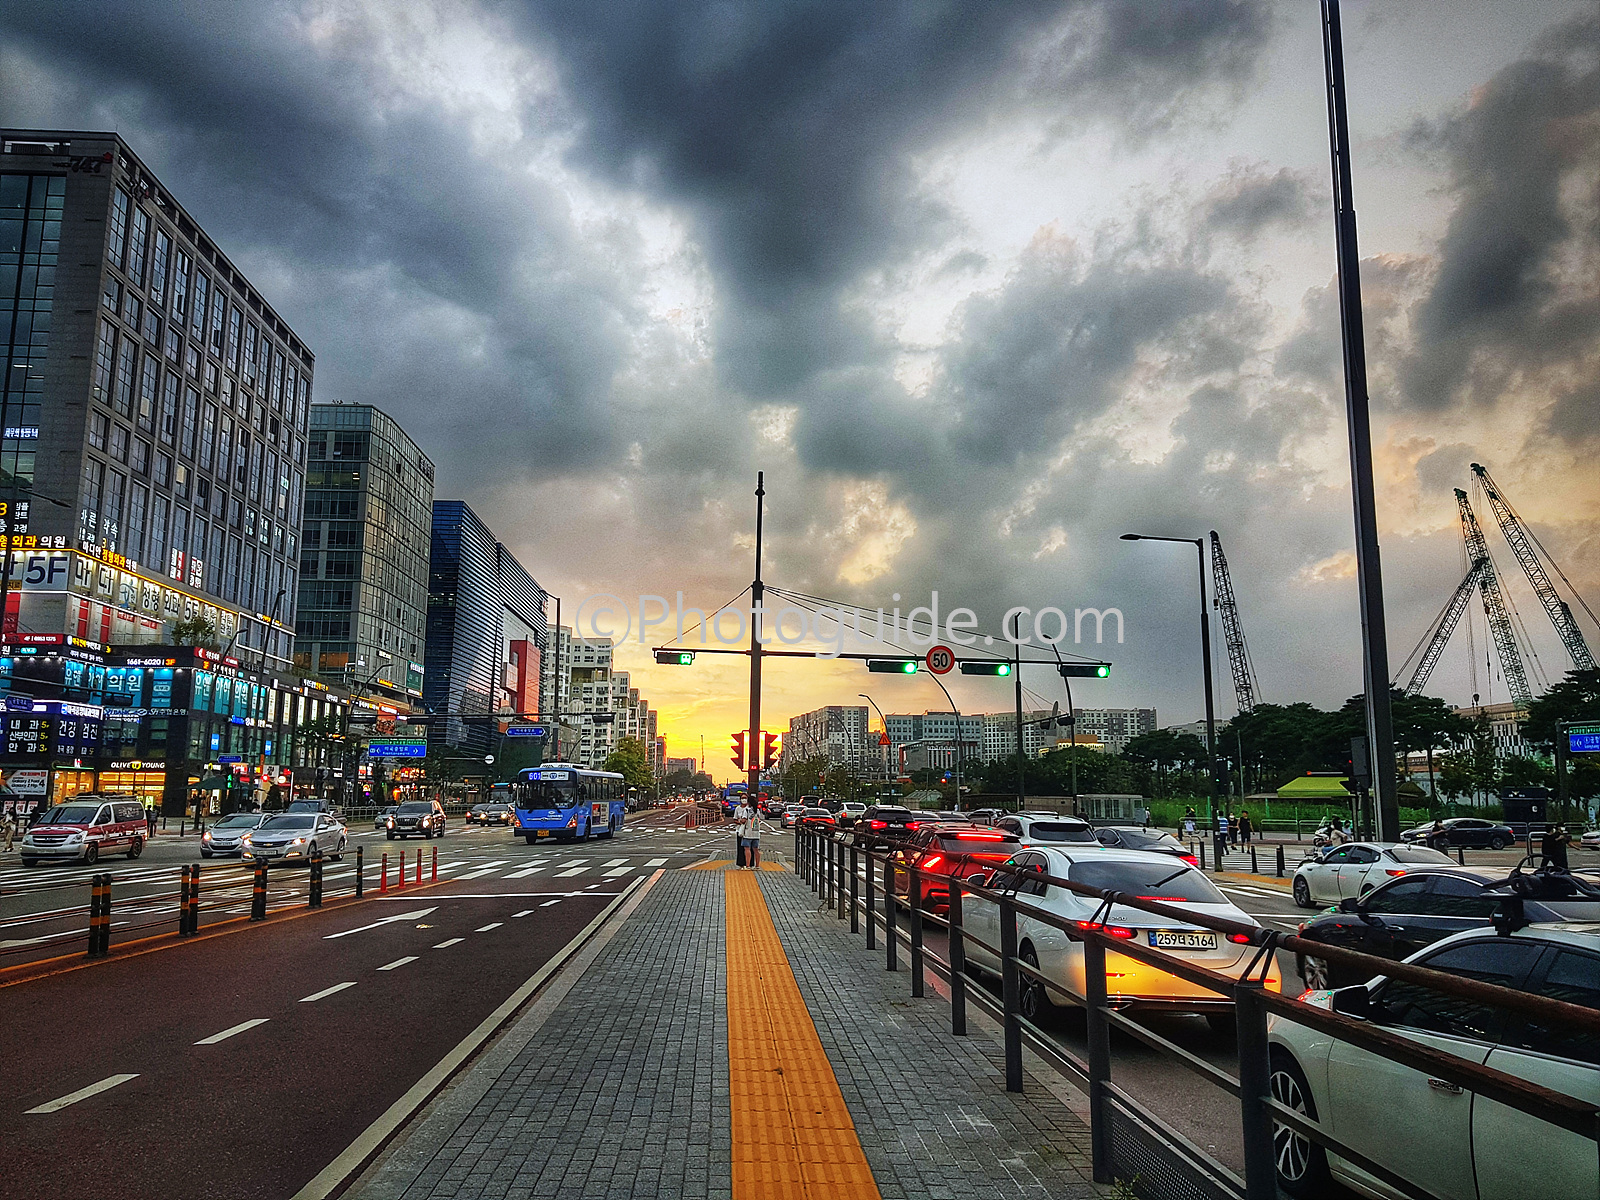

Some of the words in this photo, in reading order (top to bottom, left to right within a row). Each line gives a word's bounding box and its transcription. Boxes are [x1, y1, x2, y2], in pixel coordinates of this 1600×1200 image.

[40, 535, 66, 549] 의원
[25, 556, 68, 585] 5F
[933, 653, 949, 667] 50
[107, 674, 142, 692] 의원
[9, 731, 38, 741] 산부인과
[110, 761, 132, 769] OLIVE
[141, 761, 166, 769] YOUNG
[1157, 933, 1187, 947] 259더
[1187, 934, 1215, 947] 3164
